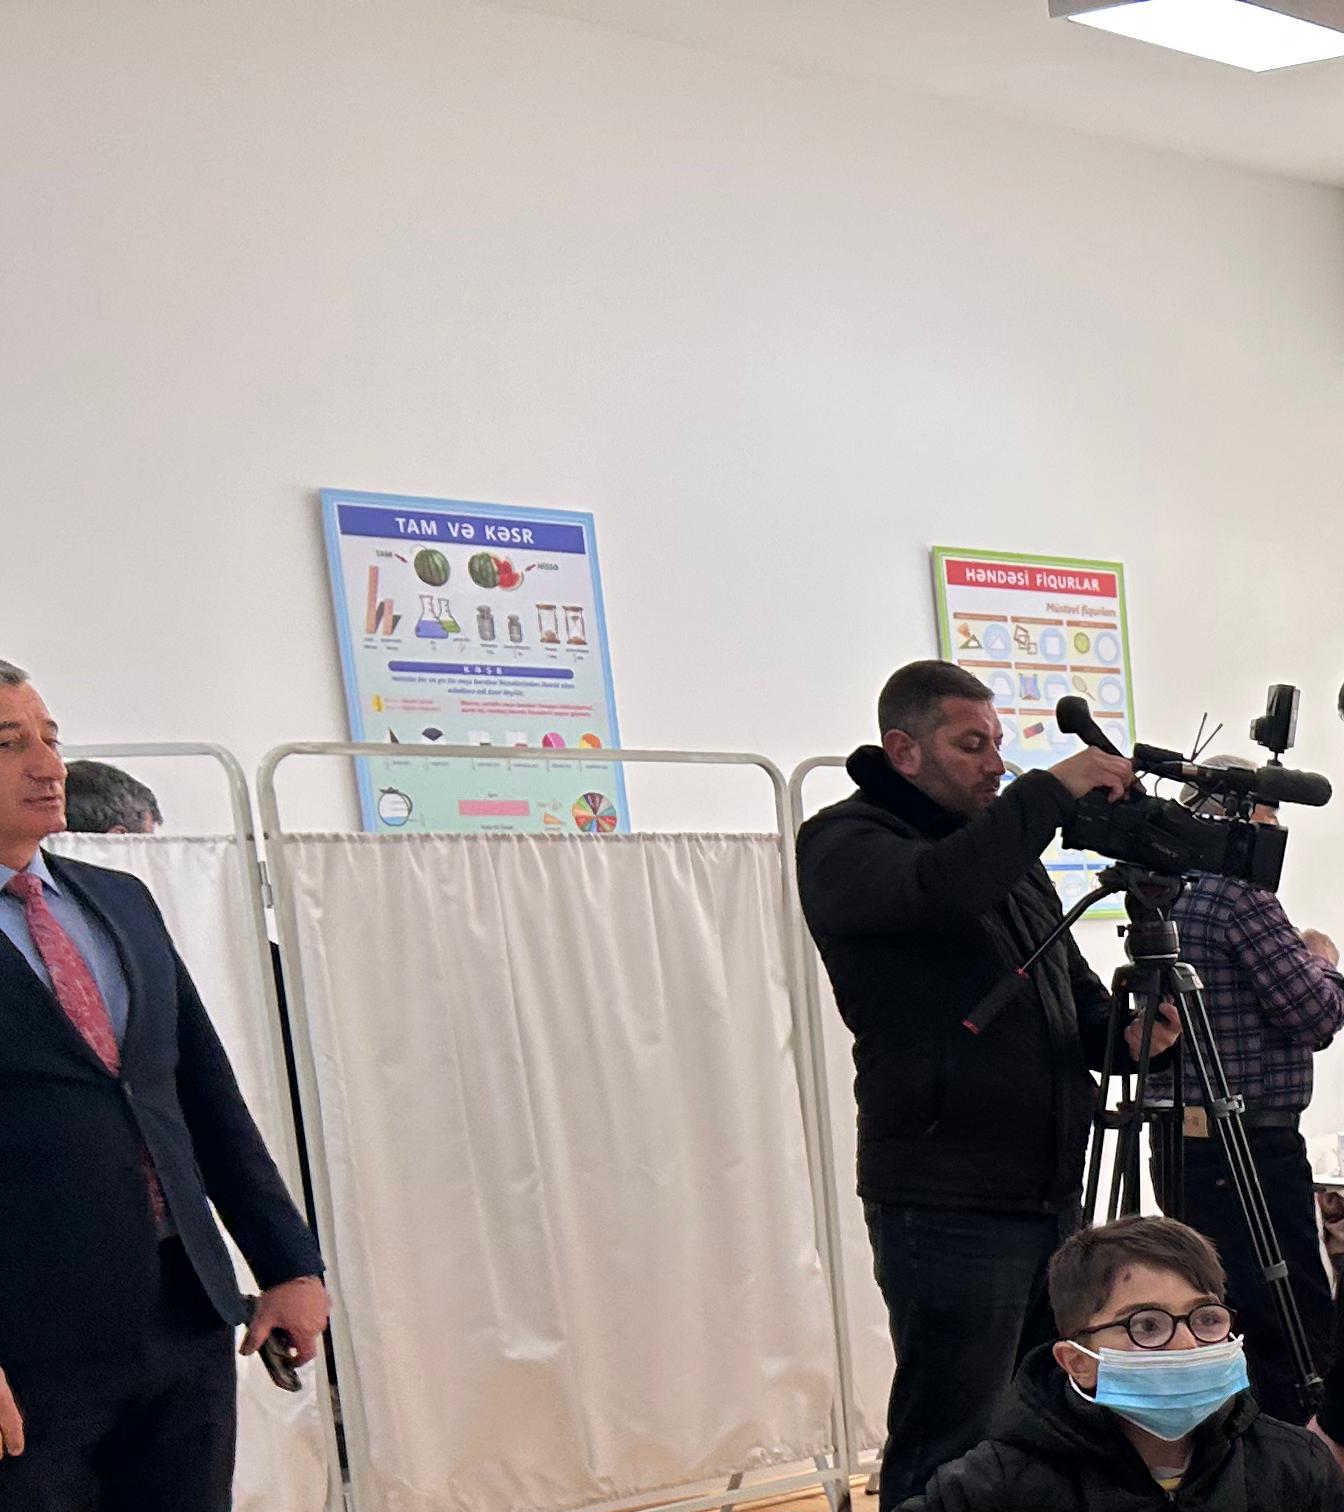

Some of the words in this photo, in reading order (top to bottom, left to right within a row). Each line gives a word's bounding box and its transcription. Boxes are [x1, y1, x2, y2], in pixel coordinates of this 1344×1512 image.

[394, 517, 437, 536] TAM
[448, 522, 475, 539] VƏ
[484, 525, 535, 544] KƏSR
[965, 567, 1030, 587] HƏNDƏSİ
[1036, 572, 1101, 593] FİQURLAR
